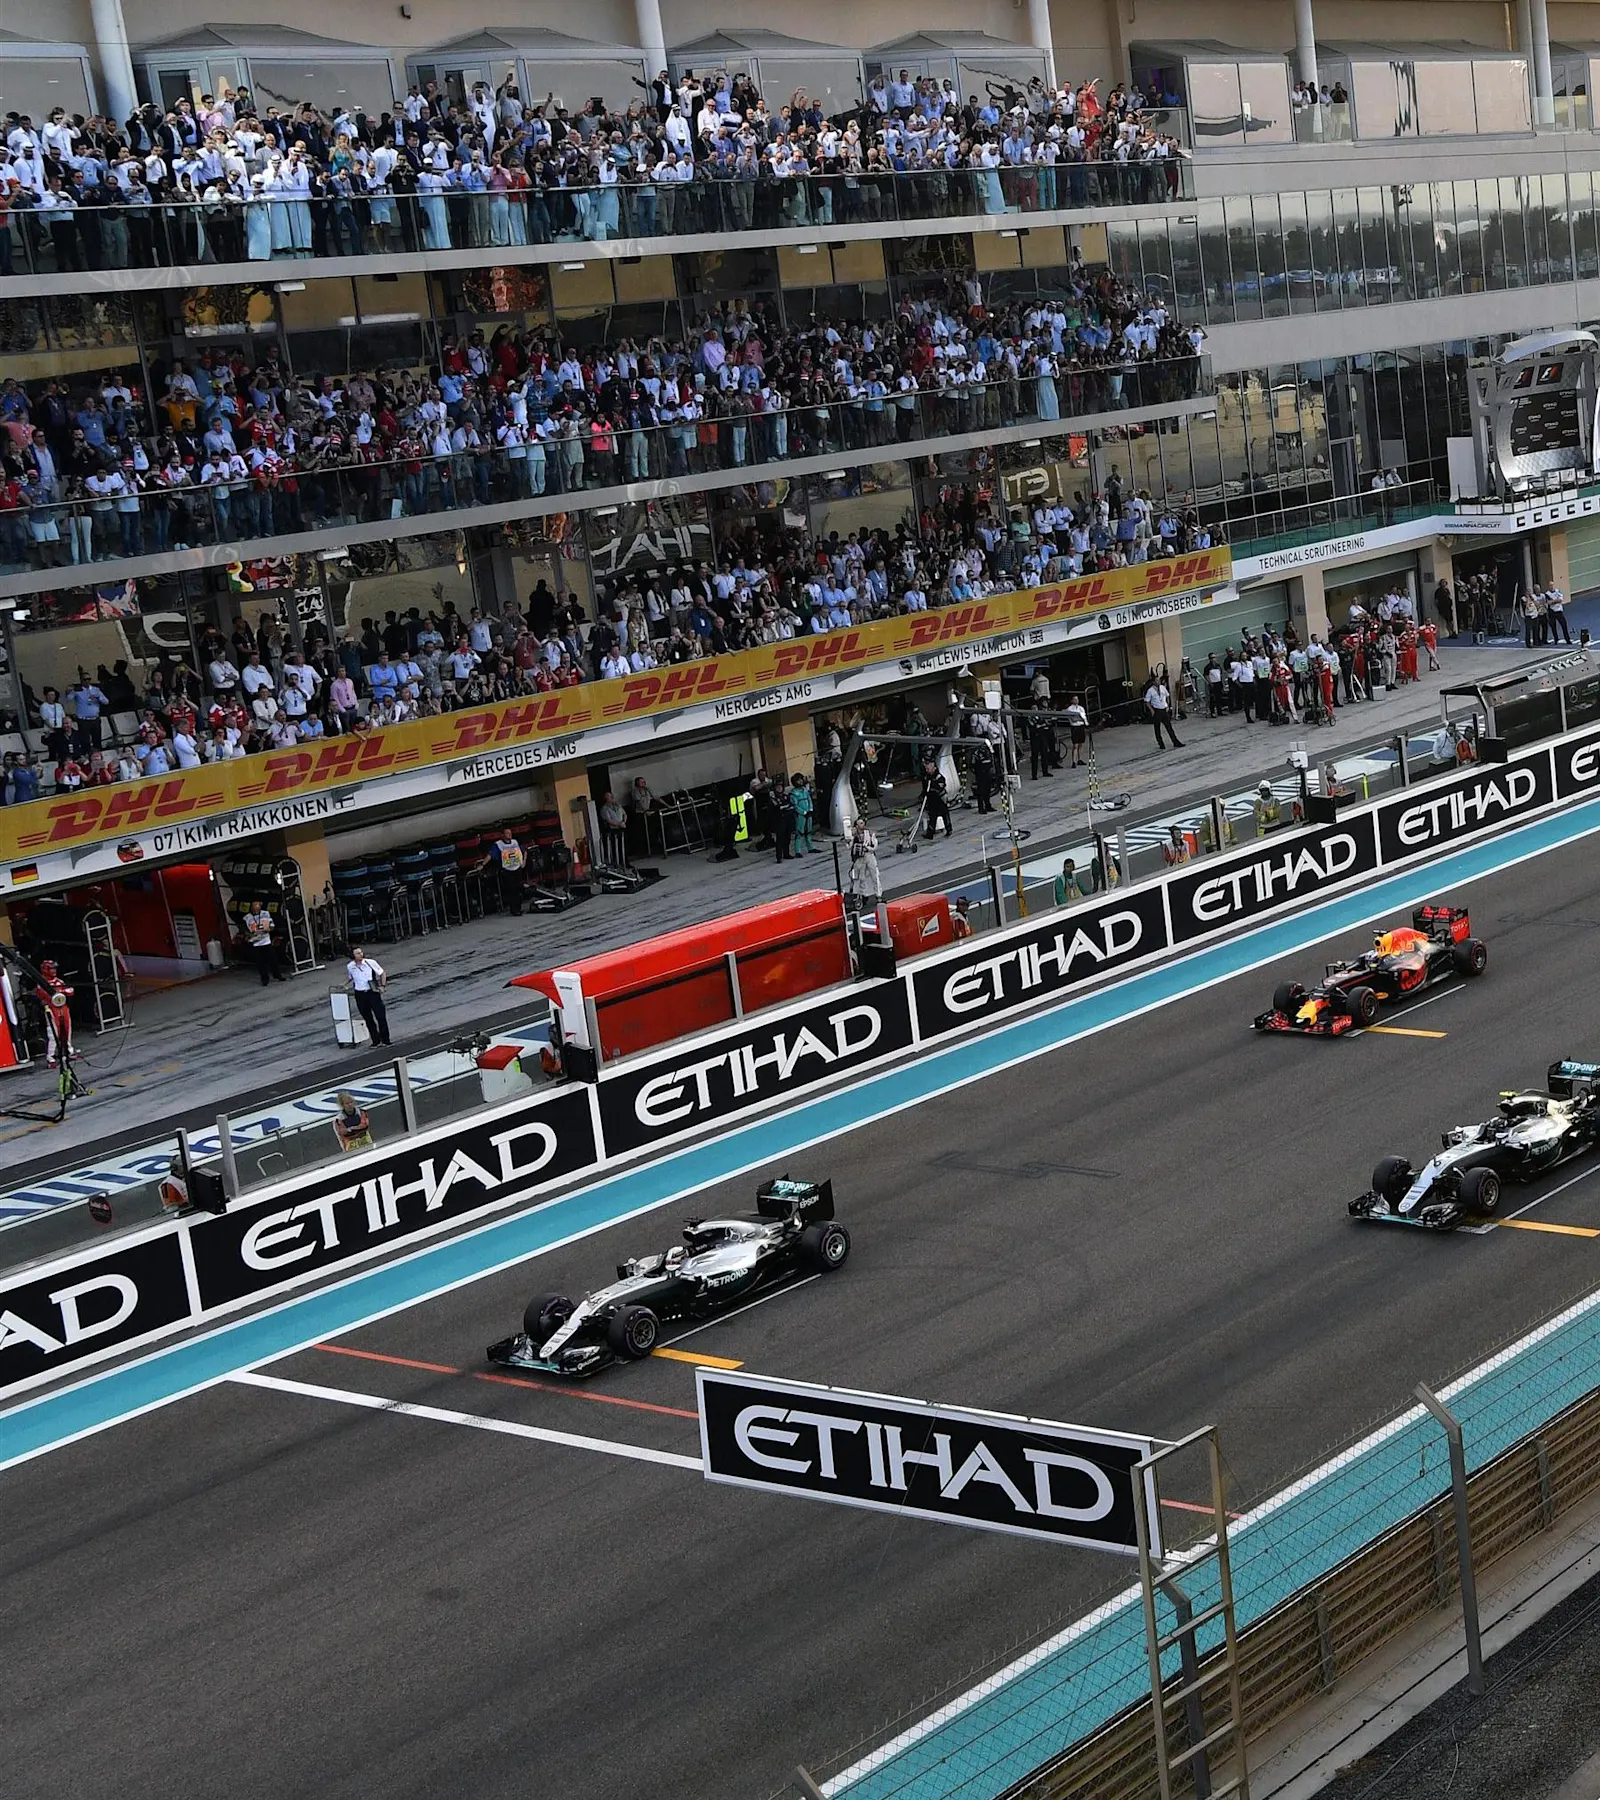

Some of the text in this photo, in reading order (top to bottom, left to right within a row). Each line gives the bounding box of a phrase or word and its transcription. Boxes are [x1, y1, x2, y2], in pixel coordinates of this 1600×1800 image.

[1146, 556, 1214, 592] DHL
[1259, 537, 1365, 570] TECHNICAL SCRUTINEERING
[1033, 579, 1113, 620] DHL
[1117, 612, 1127, 625] 06
[1156, 595, 1198, 617] ROSBERG
[910, 604, 1004, 647] DHL
[774, 632, 871, 678] DHL
[937, 648, 970, 667] LEWIS
[973, 635, 1026, 659] HAMILTON
[622, 664, 728, 712] DHL
[715, 683, 812, 719] MERCEDES AMG
[453, 697, 573, 750] DHL
[264, 735, 396, 793] DHL
[463, 741, 577, 781] MERCEDES AMG
[46, 778, 199, 843] DHL
[153, 830, 174, 853] 07
[228, 797, 330, 836] RÄIKKÖNEN
[1397, 768, 1537, 845] ETIHAD
[1192, 832, 1358, 922] ETIHAD
[942, 911, 1143, 1013] ETIHAD
[634, 1004, 882, 1127] ETIHAD
[241, 1121, 558, 1270] ETIHAD
[799, 1193, 820, 1209] EPSON
[707, 1266, 749, 1289] PETRONAS
[734, 1404, 1115, 1522] ETIHAD
